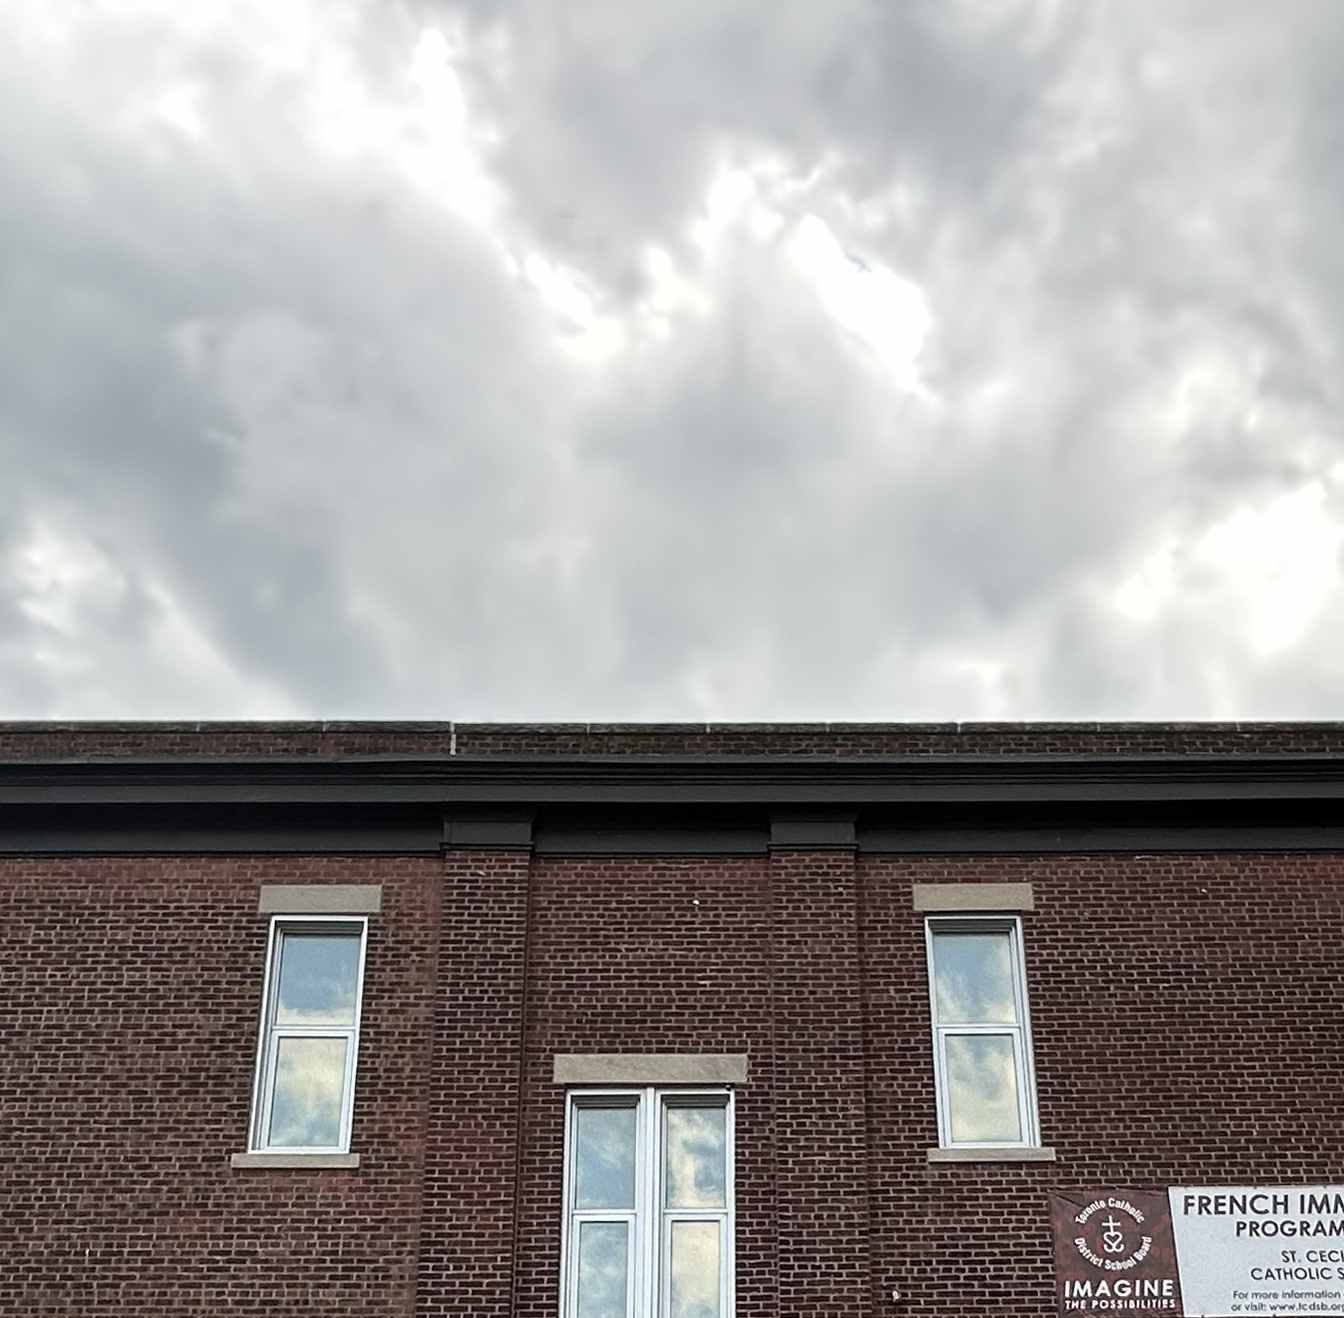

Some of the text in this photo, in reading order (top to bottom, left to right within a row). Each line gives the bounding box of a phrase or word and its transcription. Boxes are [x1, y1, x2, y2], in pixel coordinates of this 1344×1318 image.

[1075, 1197, 1145, 1224] Toronto Catholic
[1183, 1193, 1289, 1216] FRENCH
[1074, 1236, 1152, 1271] District School Board
[1281, 1250, 1302, 1263] ST.
[1250, 1267, 1333, 1281] CATHOLIC
[1064, 1279, 1174, 1298] IMAGINE
[1233, 1290, 1249, 1300] For
[1251, 1291, 1279, 1299] more
[1282, 1289, 1341, 1299] information
[1065, 1299, 1176, 1310] THE POSSIBILITIES
[1231, 1303, 1242, 1312] or
